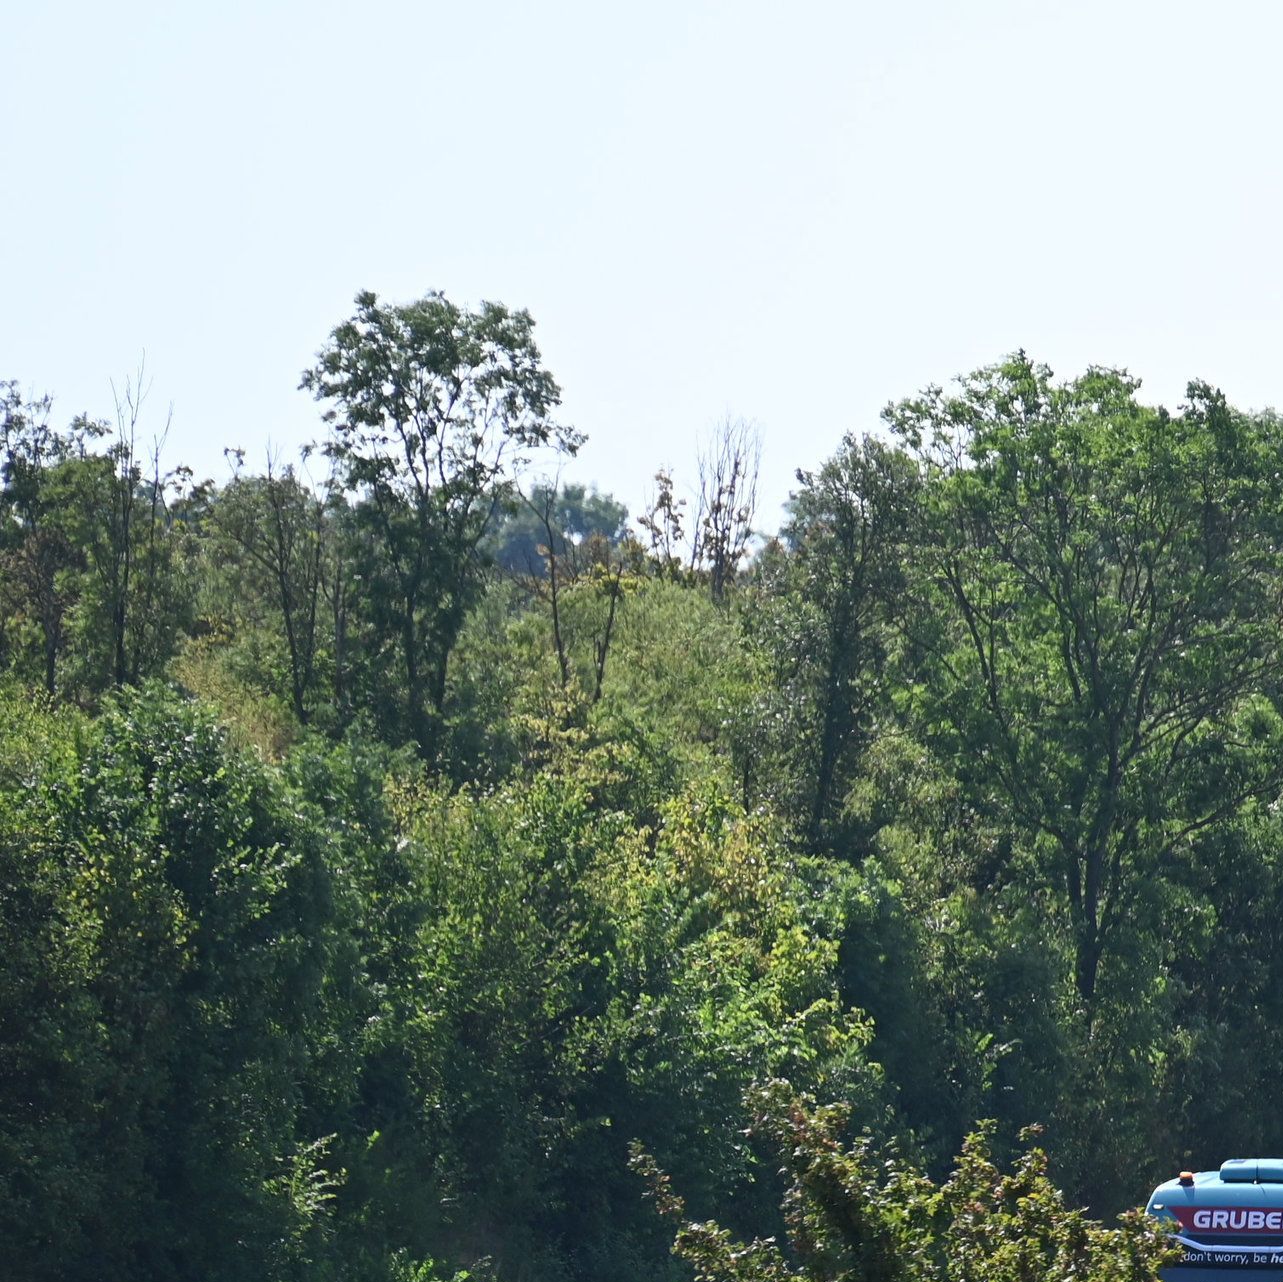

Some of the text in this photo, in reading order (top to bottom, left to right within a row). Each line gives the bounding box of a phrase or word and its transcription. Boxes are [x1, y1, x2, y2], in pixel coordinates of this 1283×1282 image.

[1183, 1251, 1212, 1262] don't
[1214, 1253, 1249, 1265] worry,
[1253, 1252, 1267, 1263] be
